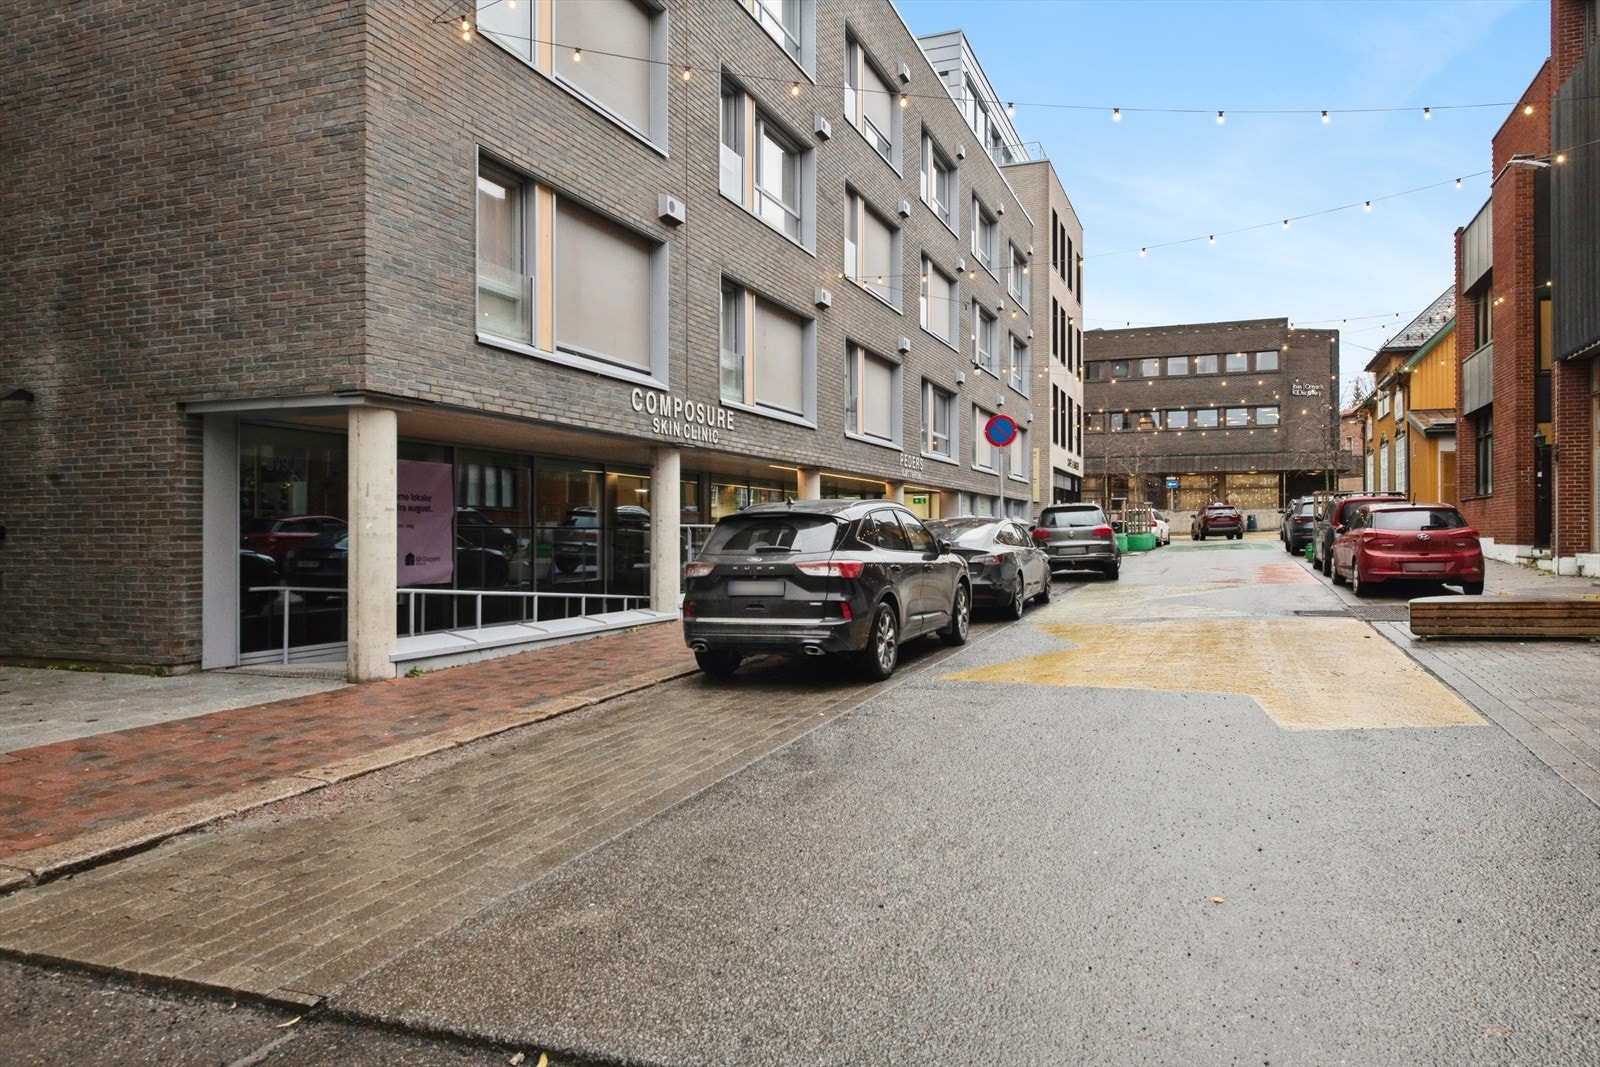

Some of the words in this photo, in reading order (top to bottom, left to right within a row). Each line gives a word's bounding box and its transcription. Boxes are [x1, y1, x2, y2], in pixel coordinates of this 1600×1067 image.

[631, 387, 735, 431] COMPOSURE
[652, 417, 680, 437] SKIN
[683, 423, 719, 444] CLINIC
[900, 452, 924, 471] PEDERS
[410, 493, 433, 502] lokaler
[408, 505, 434, 514] august.
